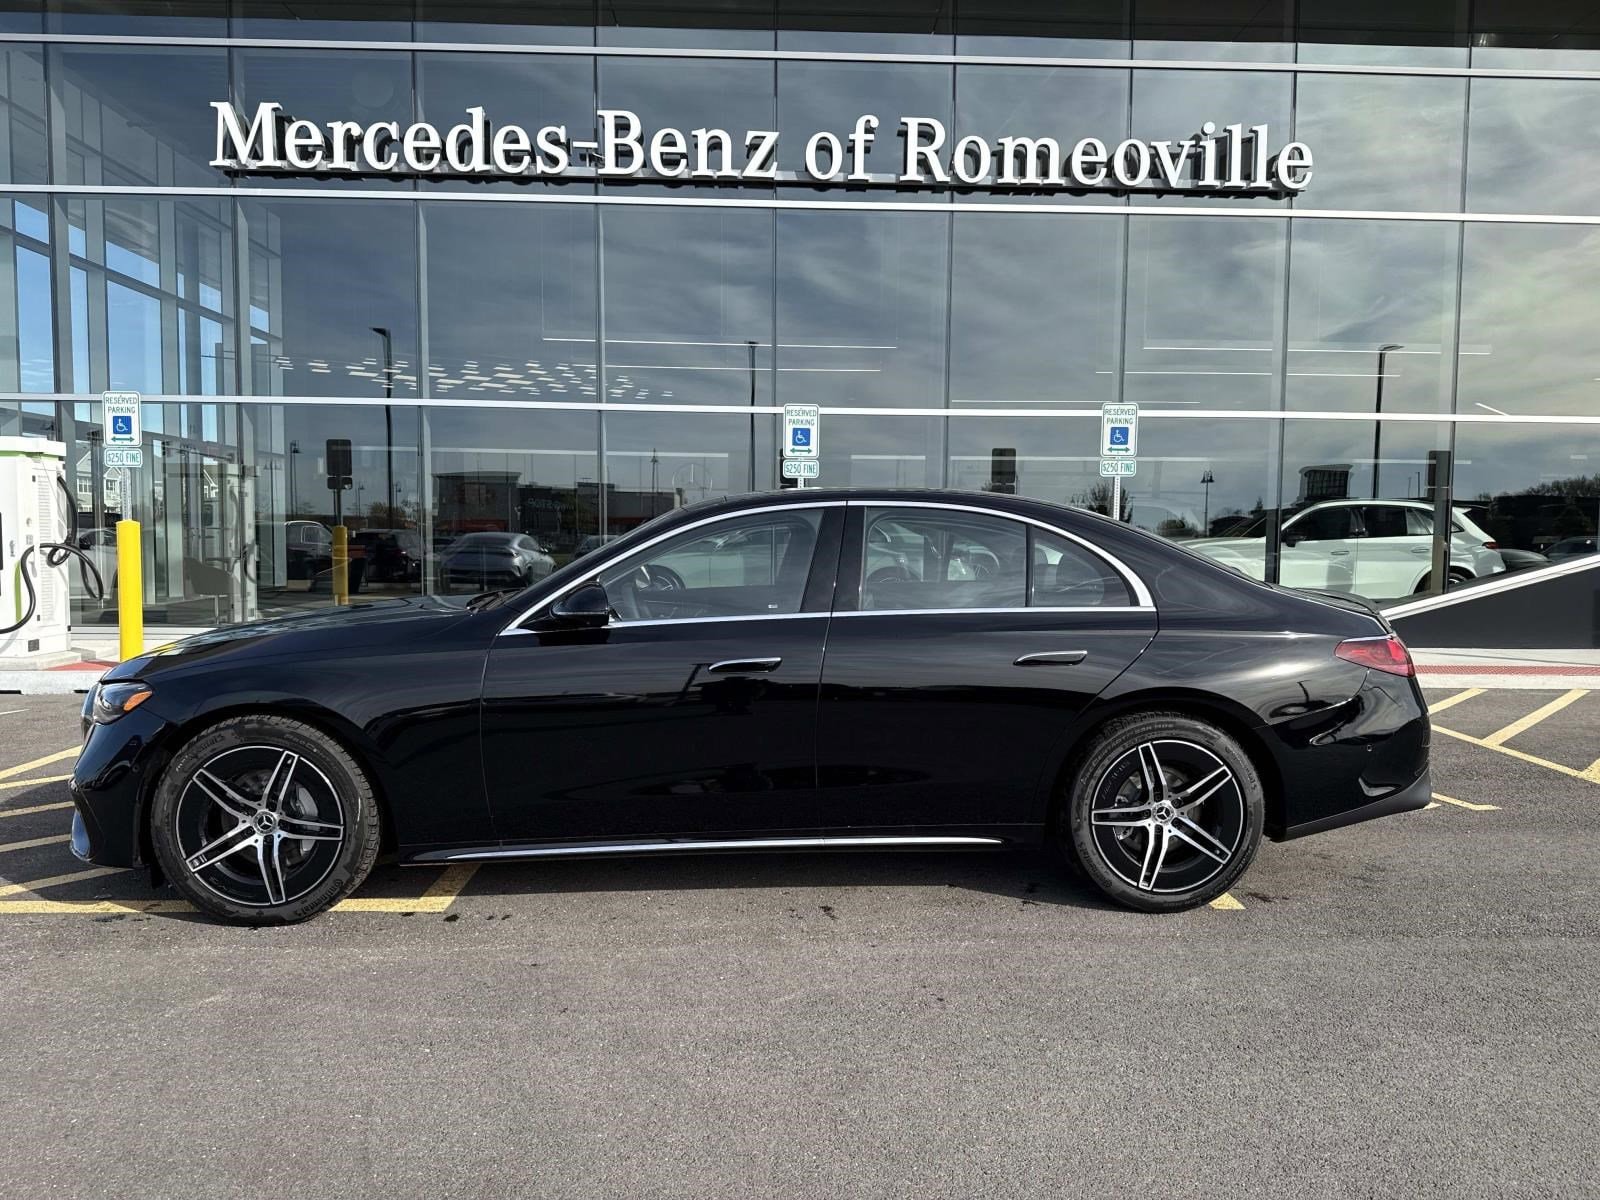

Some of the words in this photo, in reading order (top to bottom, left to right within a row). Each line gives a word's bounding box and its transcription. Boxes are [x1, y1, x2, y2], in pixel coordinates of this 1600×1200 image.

[209, 101, 780, 178] Mercedes-Benz
[805, 114, 880, 182] of
[899, 116, 1314, 190] Romeoville
[105, 396, 138, 405] RESERVED
[107, 406, 136, 414] PARKING
[786, 409, 817, 417] RESERVED
[1104, 408, 1136, 416] RESERVED
[788, 418, 815, 426] PARKING
[1106, 417, 1134, 425] PARKING
[107, 452, 124, 463] $250
[125, 452, 140, 463] FINE
[785, 463, 801, 474] $250
[803, 463, 817, 474] FINE
[1102, 462, 1118, 473] $250
[1120, 462, 1134, 473] FINE
